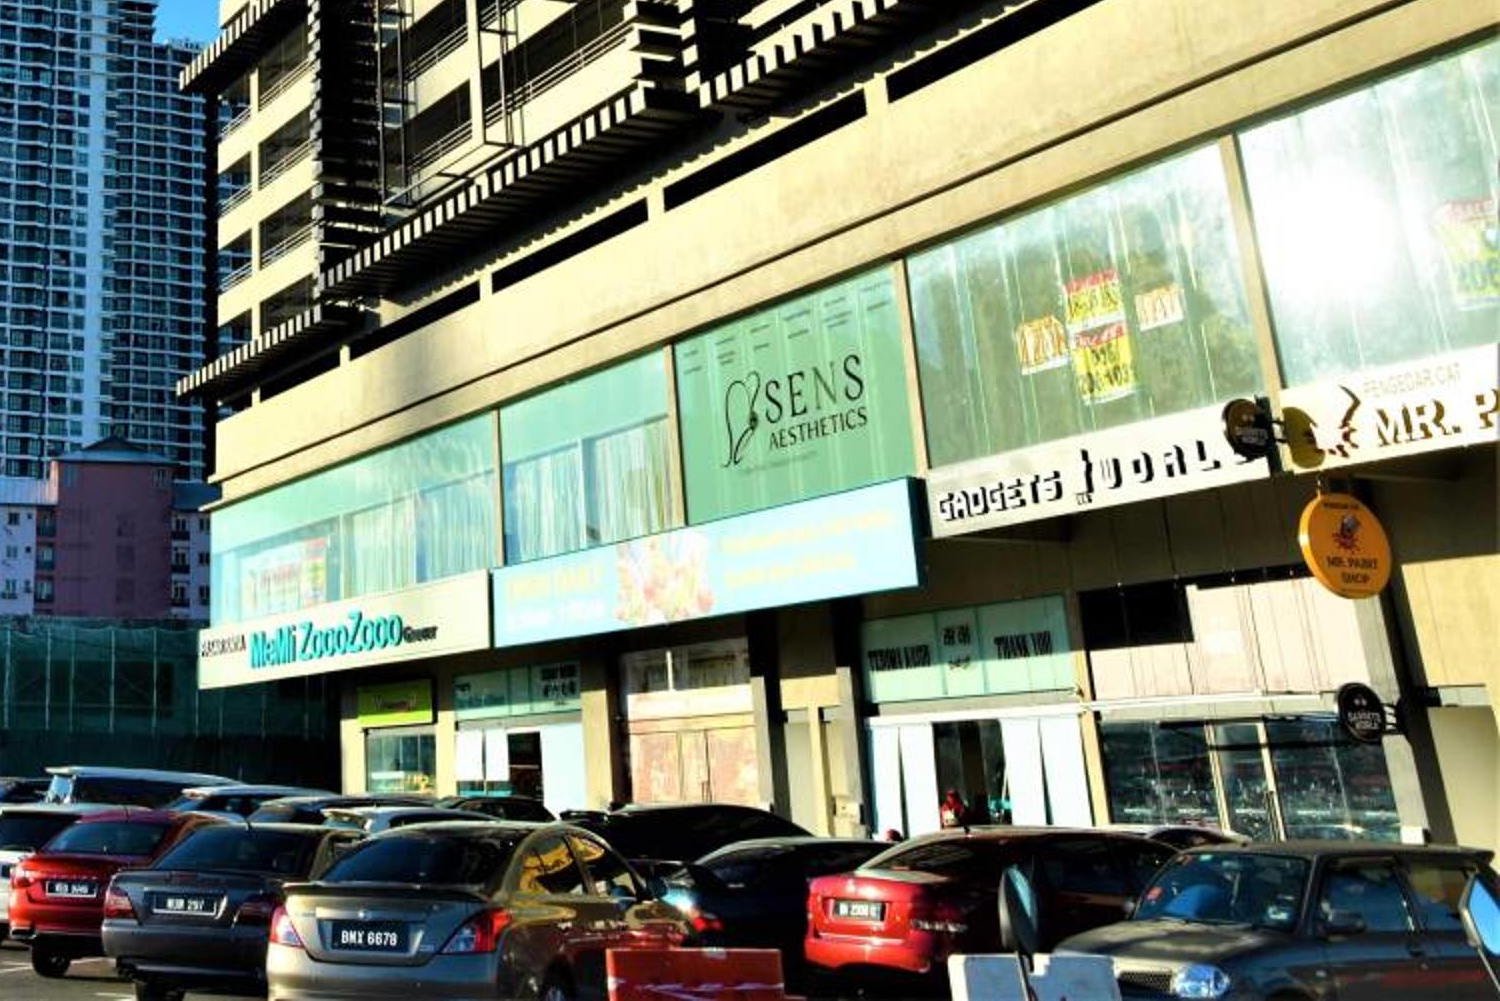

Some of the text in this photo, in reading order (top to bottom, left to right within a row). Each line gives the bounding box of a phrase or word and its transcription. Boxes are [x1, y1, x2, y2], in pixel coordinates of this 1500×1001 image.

[765, 354, 865, 424] SENS
[770, 406, 869, 450] AESTHETICS
[1374, 399, 1462, 448] MR.
[250, 625, 297, 669] MeMi
[298, 611, 404, 662] ZoooZooo
[994, 631, 1053, 660] THANK YOU
